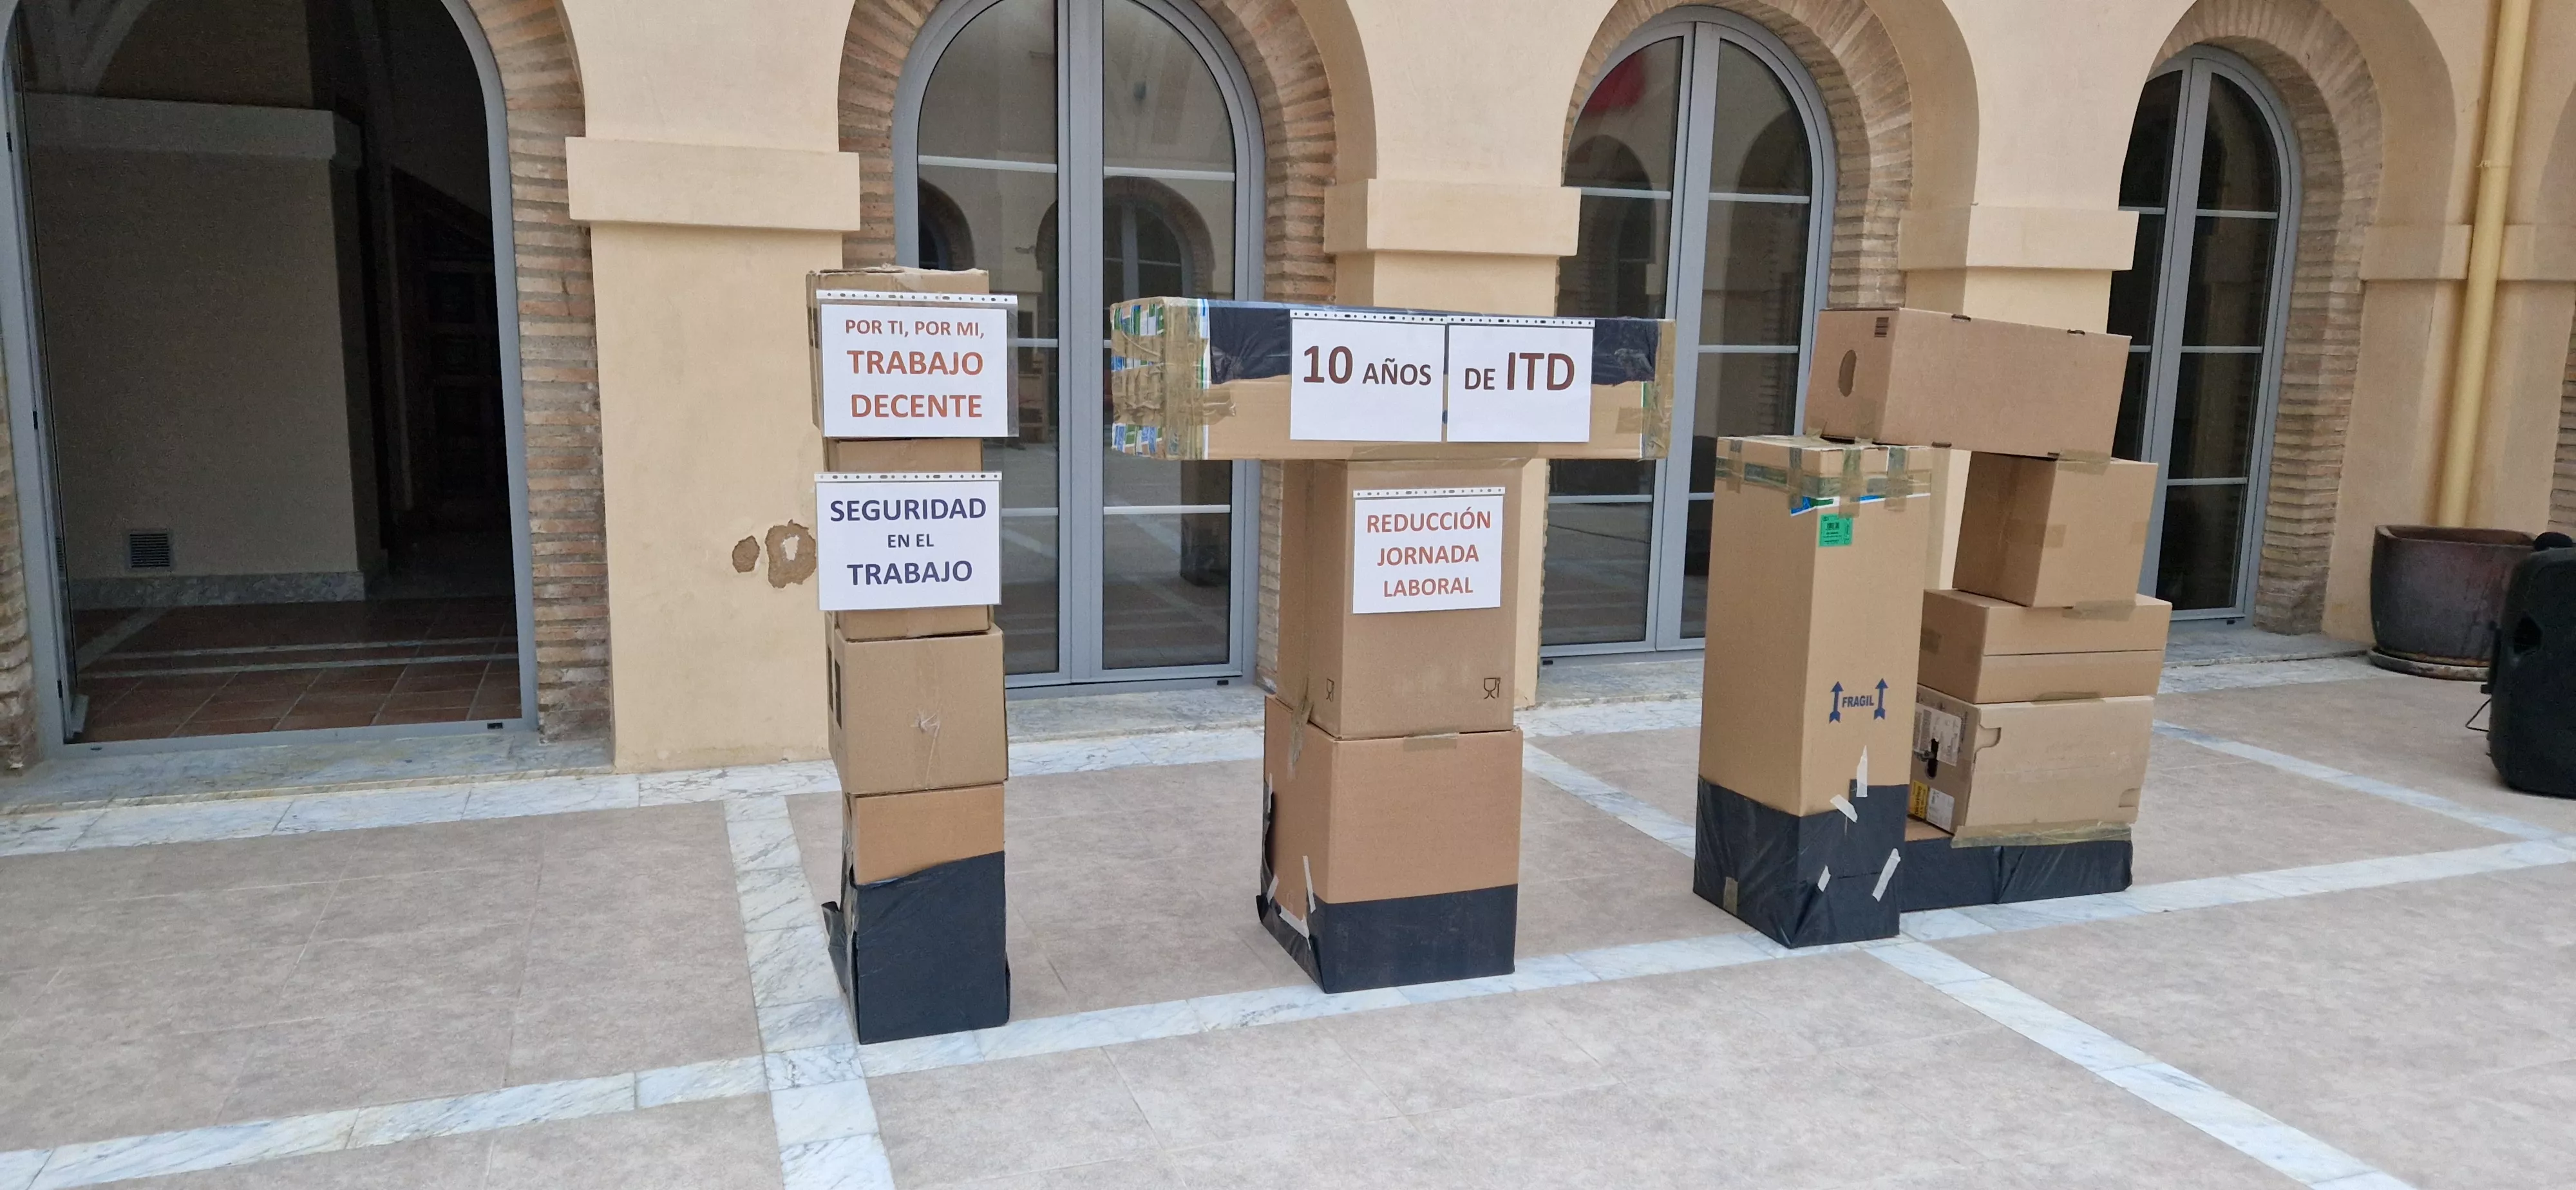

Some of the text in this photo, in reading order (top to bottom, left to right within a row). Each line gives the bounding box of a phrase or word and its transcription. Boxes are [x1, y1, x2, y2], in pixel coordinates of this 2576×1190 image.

[846, 319, 984, 339] POR TI, POR MI,
[846, 350, 983, 375] TRABAJO
[1303, 345, 1575, 391] 10 AÑOS DE ITD
[851, 393, 983, 418] DECENTE
[830, 498, 987, 522] SEGURIDAD
[1367, 506, 1492, 533] REDUCCIÓN
[887, 533, 934, 549] EN EL
[1377, 544, 1479, 567] JORNADA
[846, 560, 973, 586] TRABAJO
[1383, 576, 1473, 598] LABORAL
[1842, 695, 1875, 708] FRAGIL
